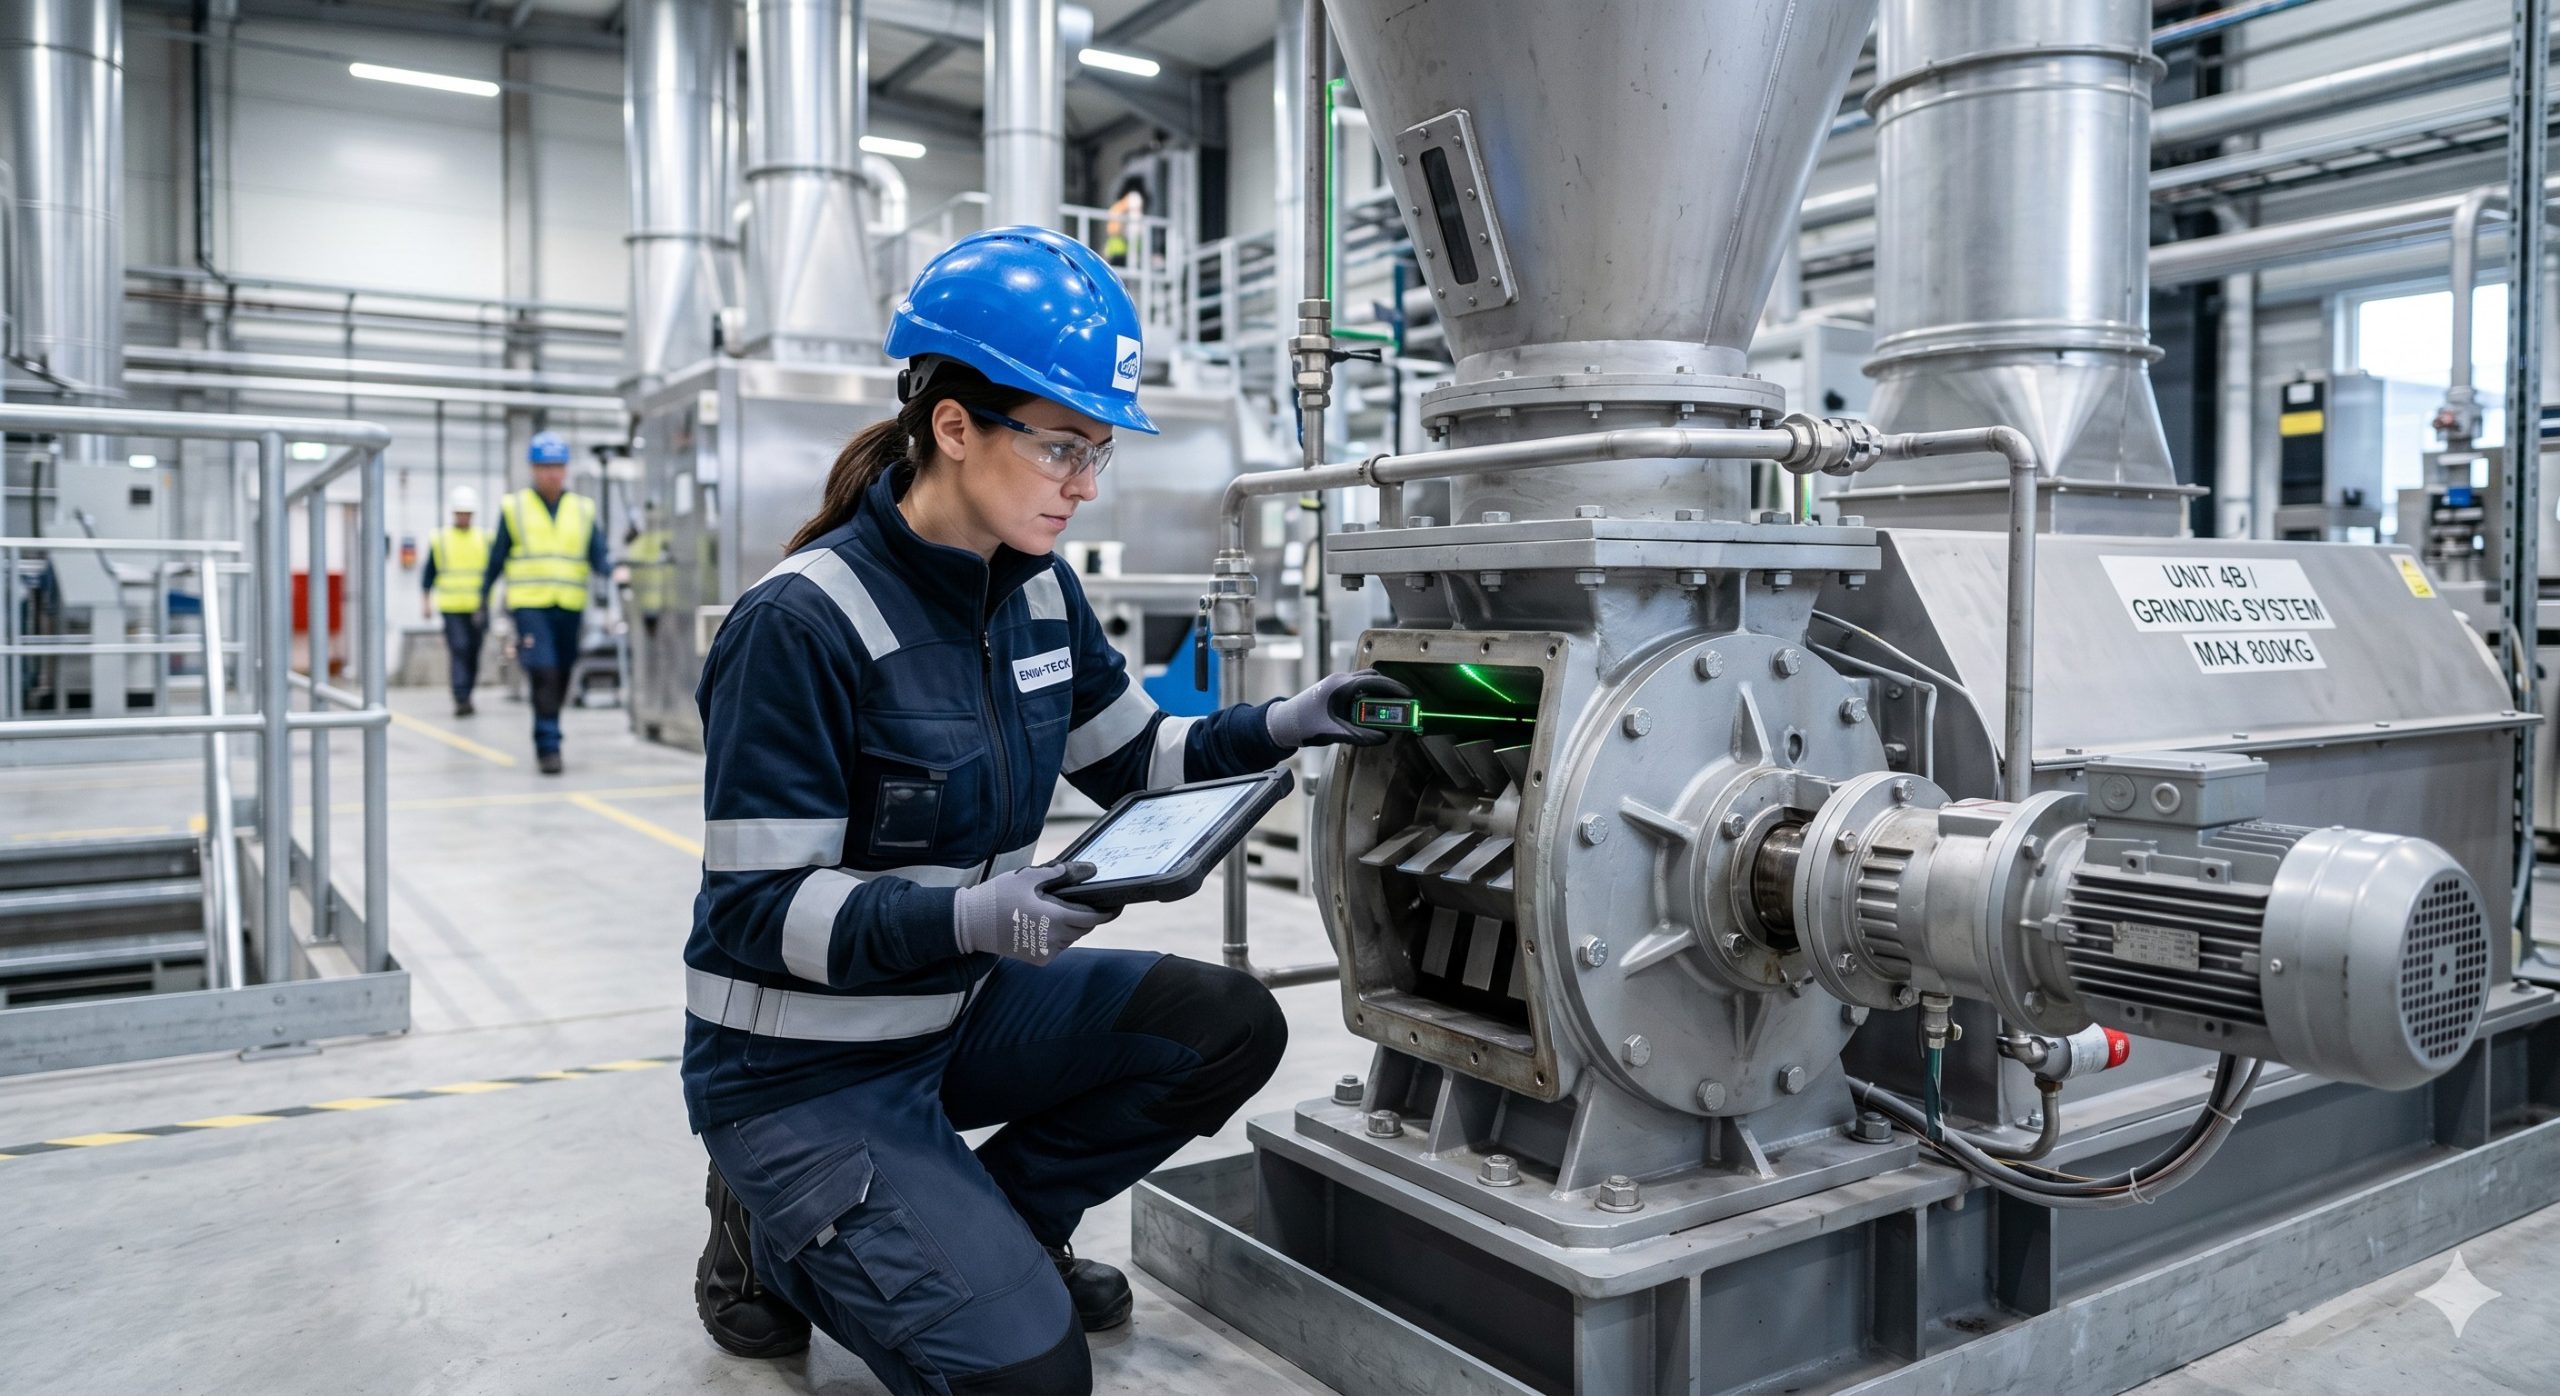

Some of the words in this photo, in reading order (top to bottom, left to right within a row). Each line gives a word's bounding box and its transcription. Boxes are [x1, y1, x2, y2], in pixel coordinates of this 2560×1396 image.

[2162, 565, 2215, 588] UNIT
[2220, 566, 2247, 588] 4B
[2132, 599, 2242, 623] GRINDING
[2242, 598, 2325, 622] SYSTEM
[2194, 641, 2249, 666] MAX
[2247, 638, 2315, 664] 800KG
